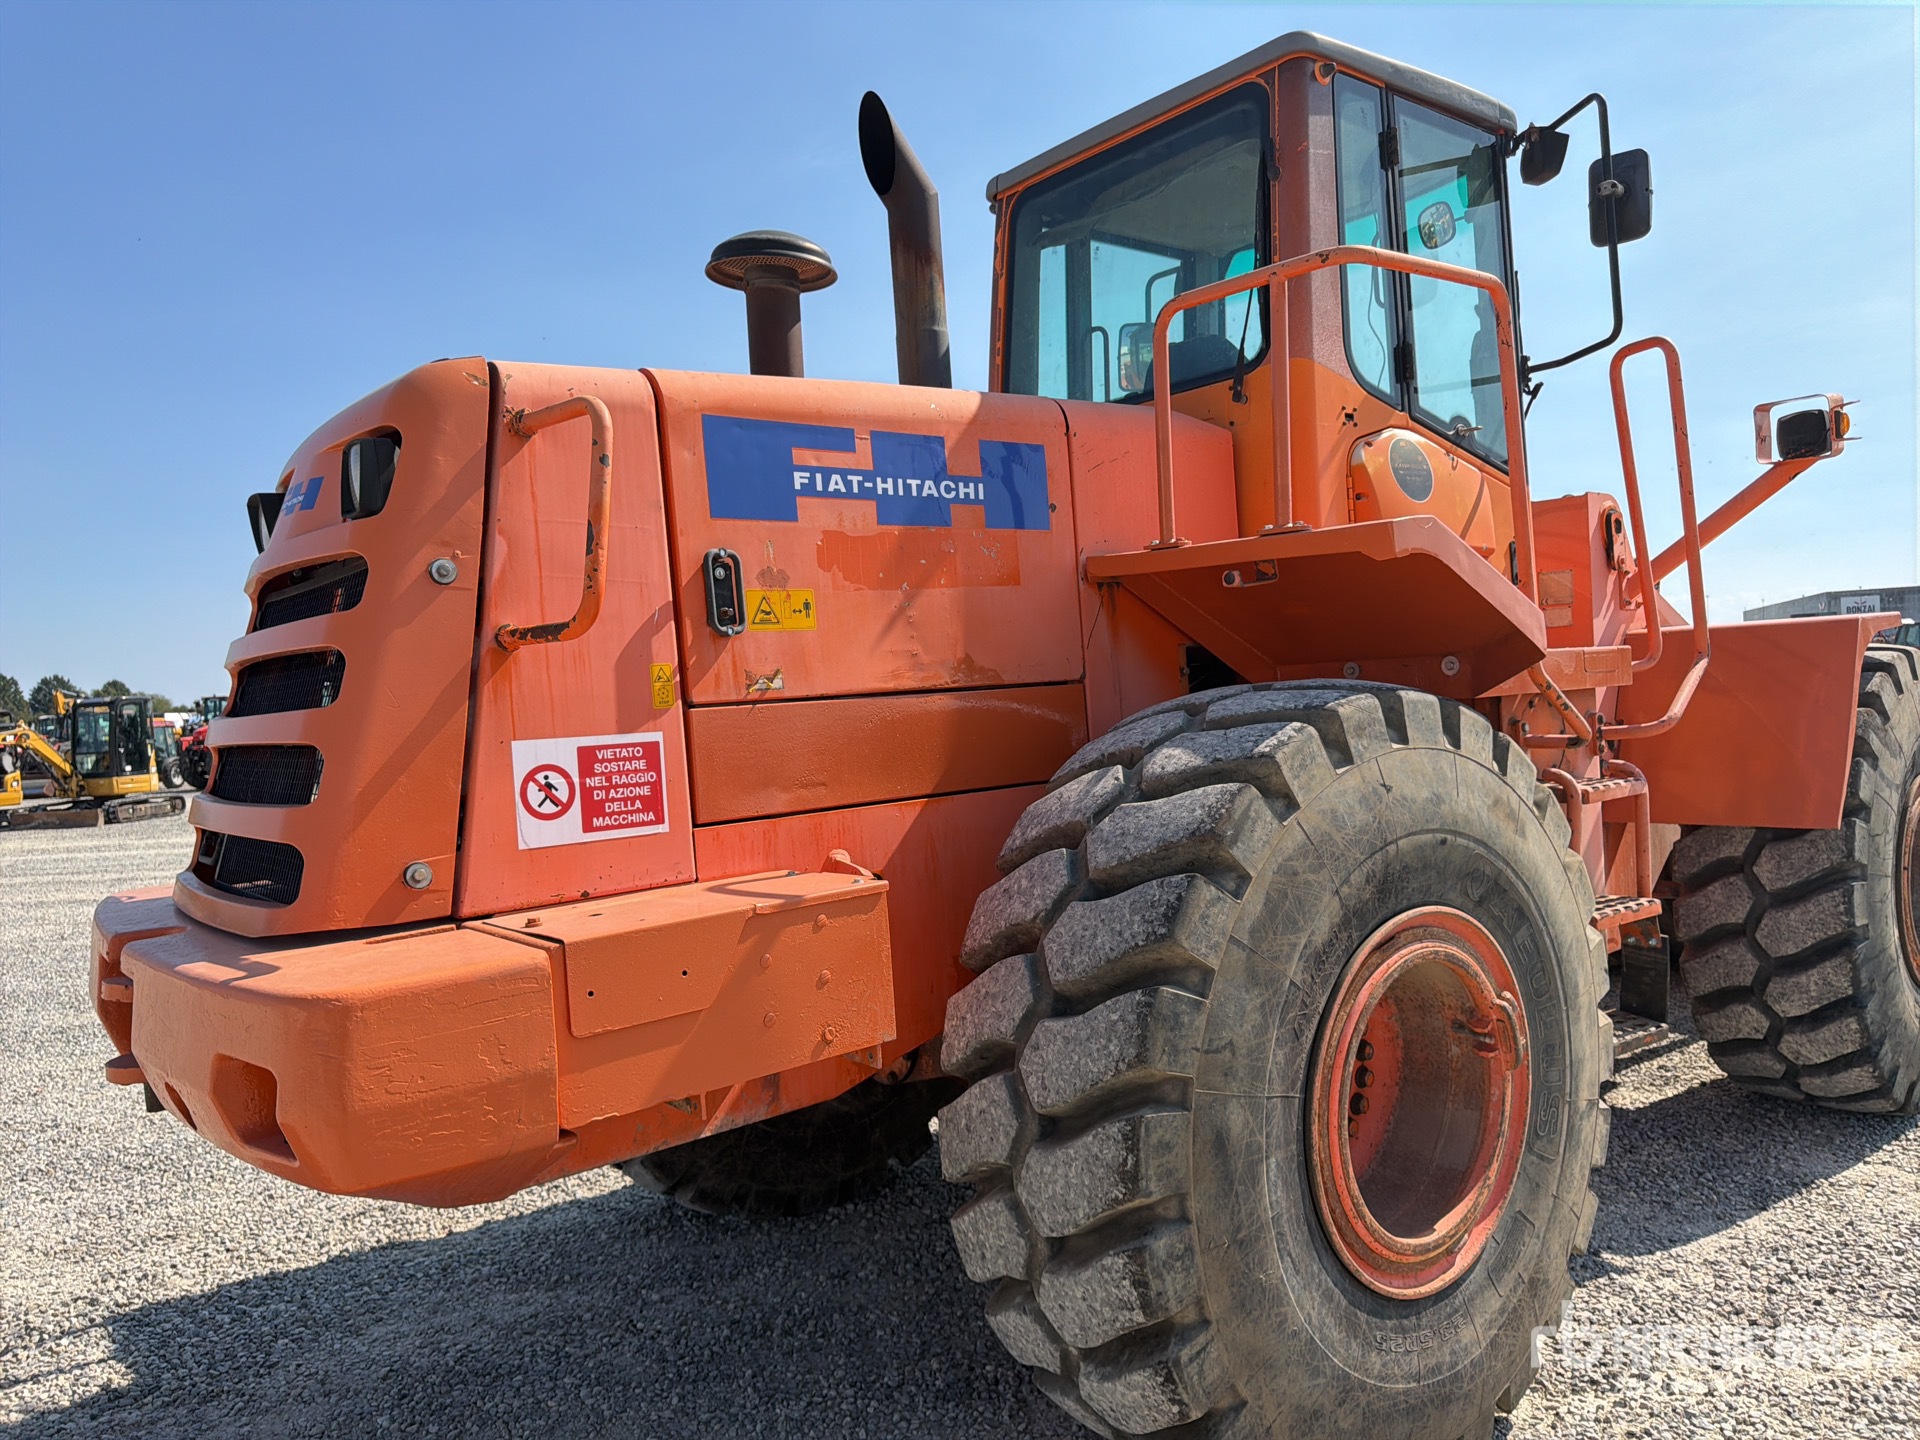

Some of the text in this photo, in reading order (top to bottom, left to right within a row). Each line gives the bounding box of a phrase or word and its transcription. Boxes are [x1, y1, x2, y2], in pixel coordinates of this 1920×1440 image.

[792, 471, 985, 500] FIAT-HITACHI
[1846, 604, 1875, 614] BONZAI
[595, 746, 643, 760] VIETATO
[593, 759, 647, 774] SOSTARE
[585, 772, 657, 788] NEL RAGGIO
[593, 786, 652, 800] DI AZIONE
[604, 800, 643, 813] DELLA
[592, 811, 656, 828] MACCHINA
